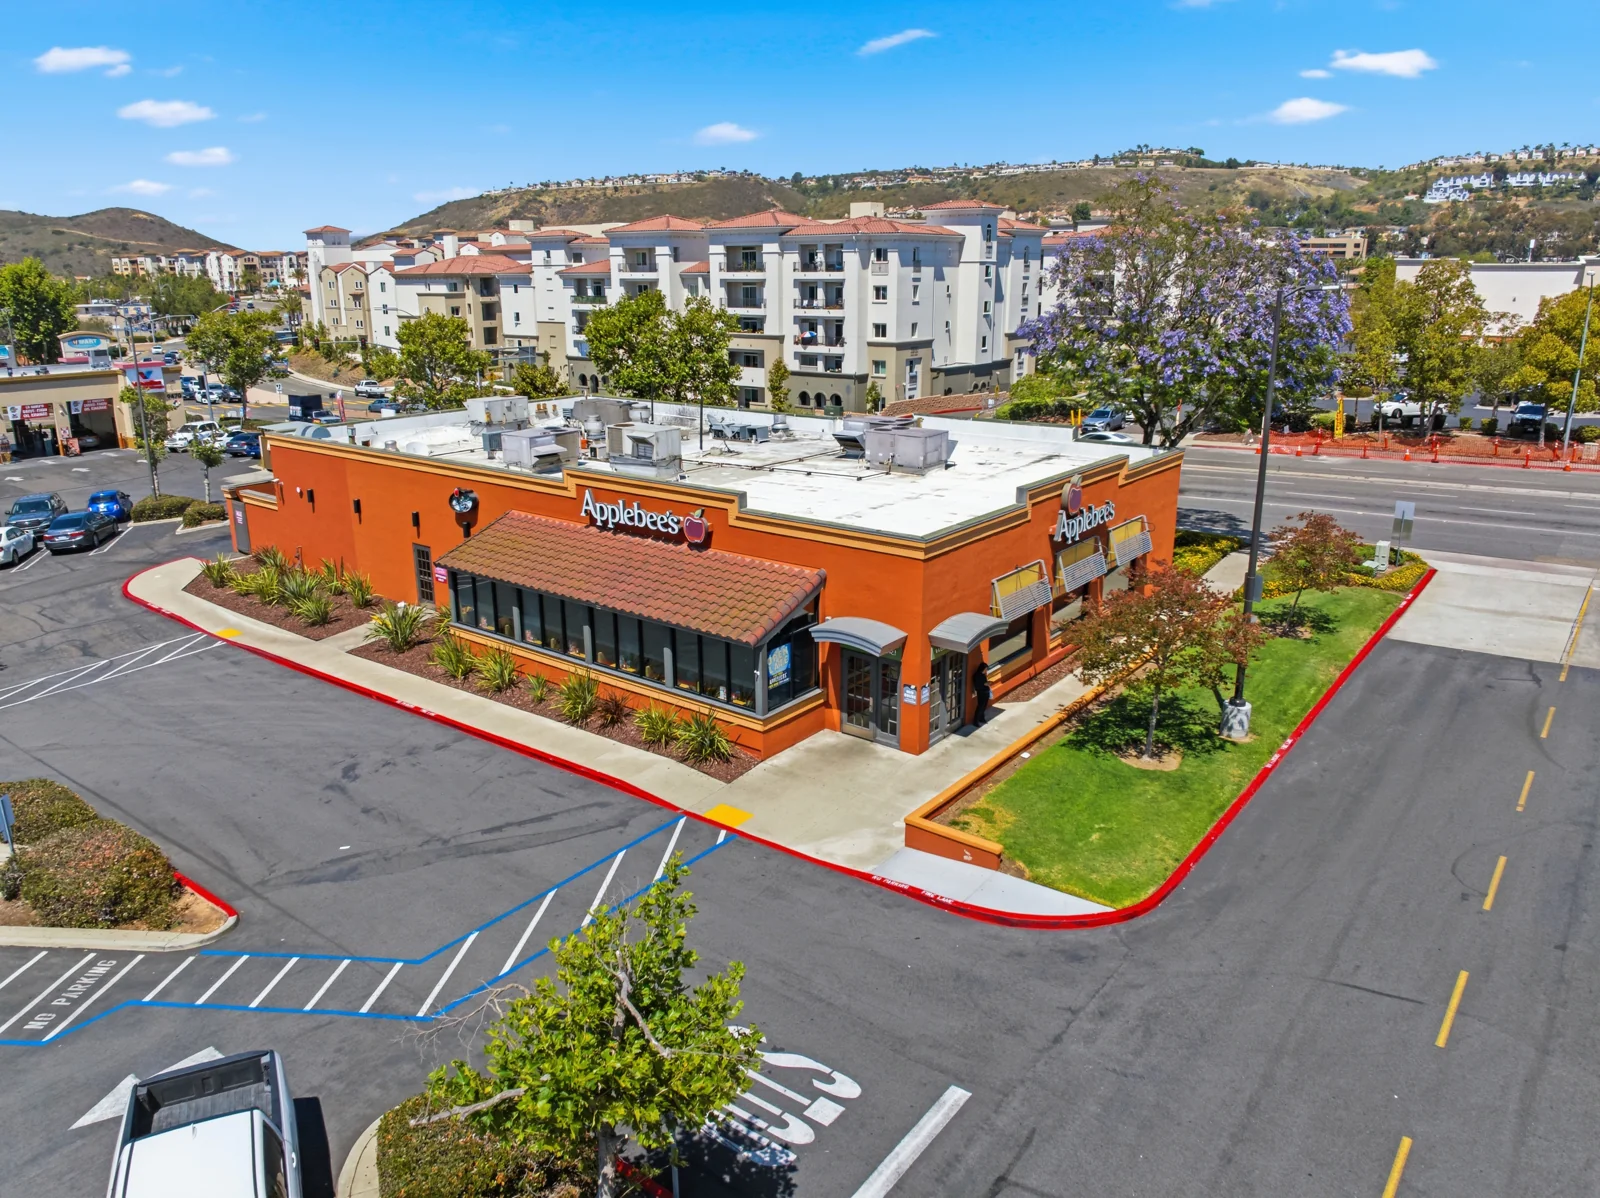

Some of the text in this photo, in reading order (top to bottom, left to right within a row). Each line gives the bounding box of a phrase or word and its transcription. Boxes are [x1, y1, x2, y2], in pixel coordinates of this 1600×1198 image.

[580, 489, 679, 534] Applebee's
[1054, 500, 1115, 544] Applebee's
[23, 960, 118, 1030] NO PARKING
